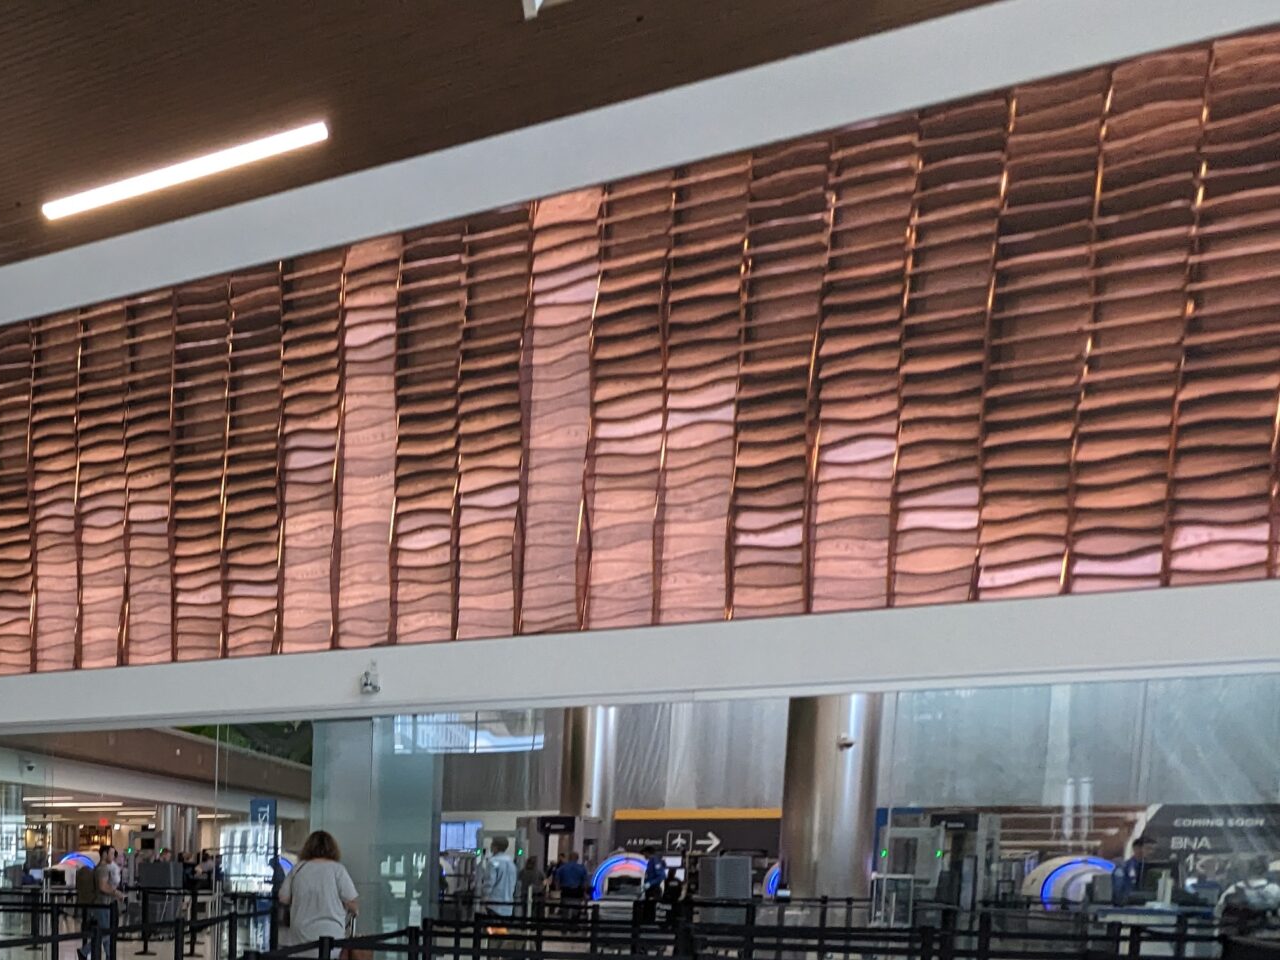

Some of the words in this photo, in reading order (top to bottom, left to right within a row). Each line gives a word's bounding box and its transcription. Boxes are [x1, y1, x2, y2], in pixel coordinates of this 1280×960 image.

[1173, 817, 1225, 828] COMING
[1226, 817, 1266, 828] SOON
[1170, 835, 1212, 850] BNA
